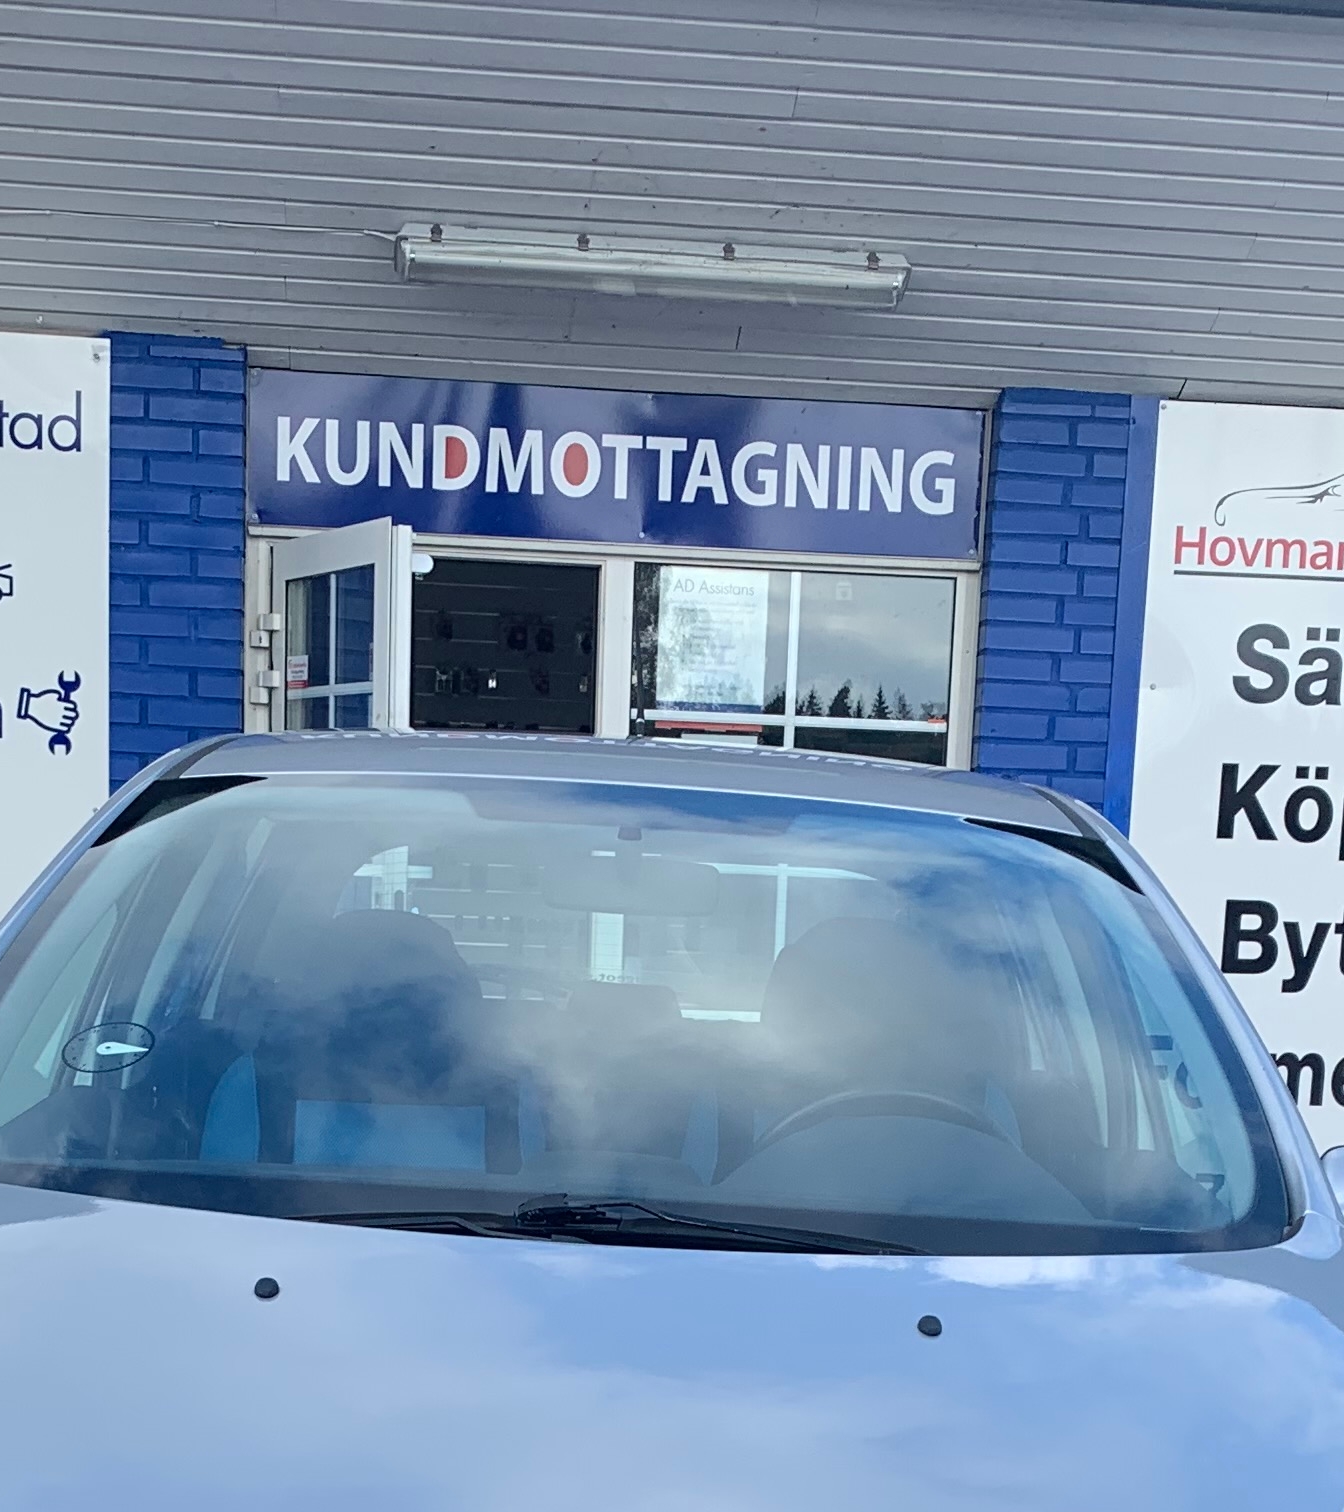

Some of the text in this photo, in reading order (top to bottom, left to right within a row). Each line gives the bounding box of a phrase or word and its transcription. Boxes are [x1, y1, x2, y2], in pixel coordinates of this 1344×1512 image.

[276, 415, 956, 517] KUNDMOTTAGNING
[673, 579, 755, 596] AD Assistans
